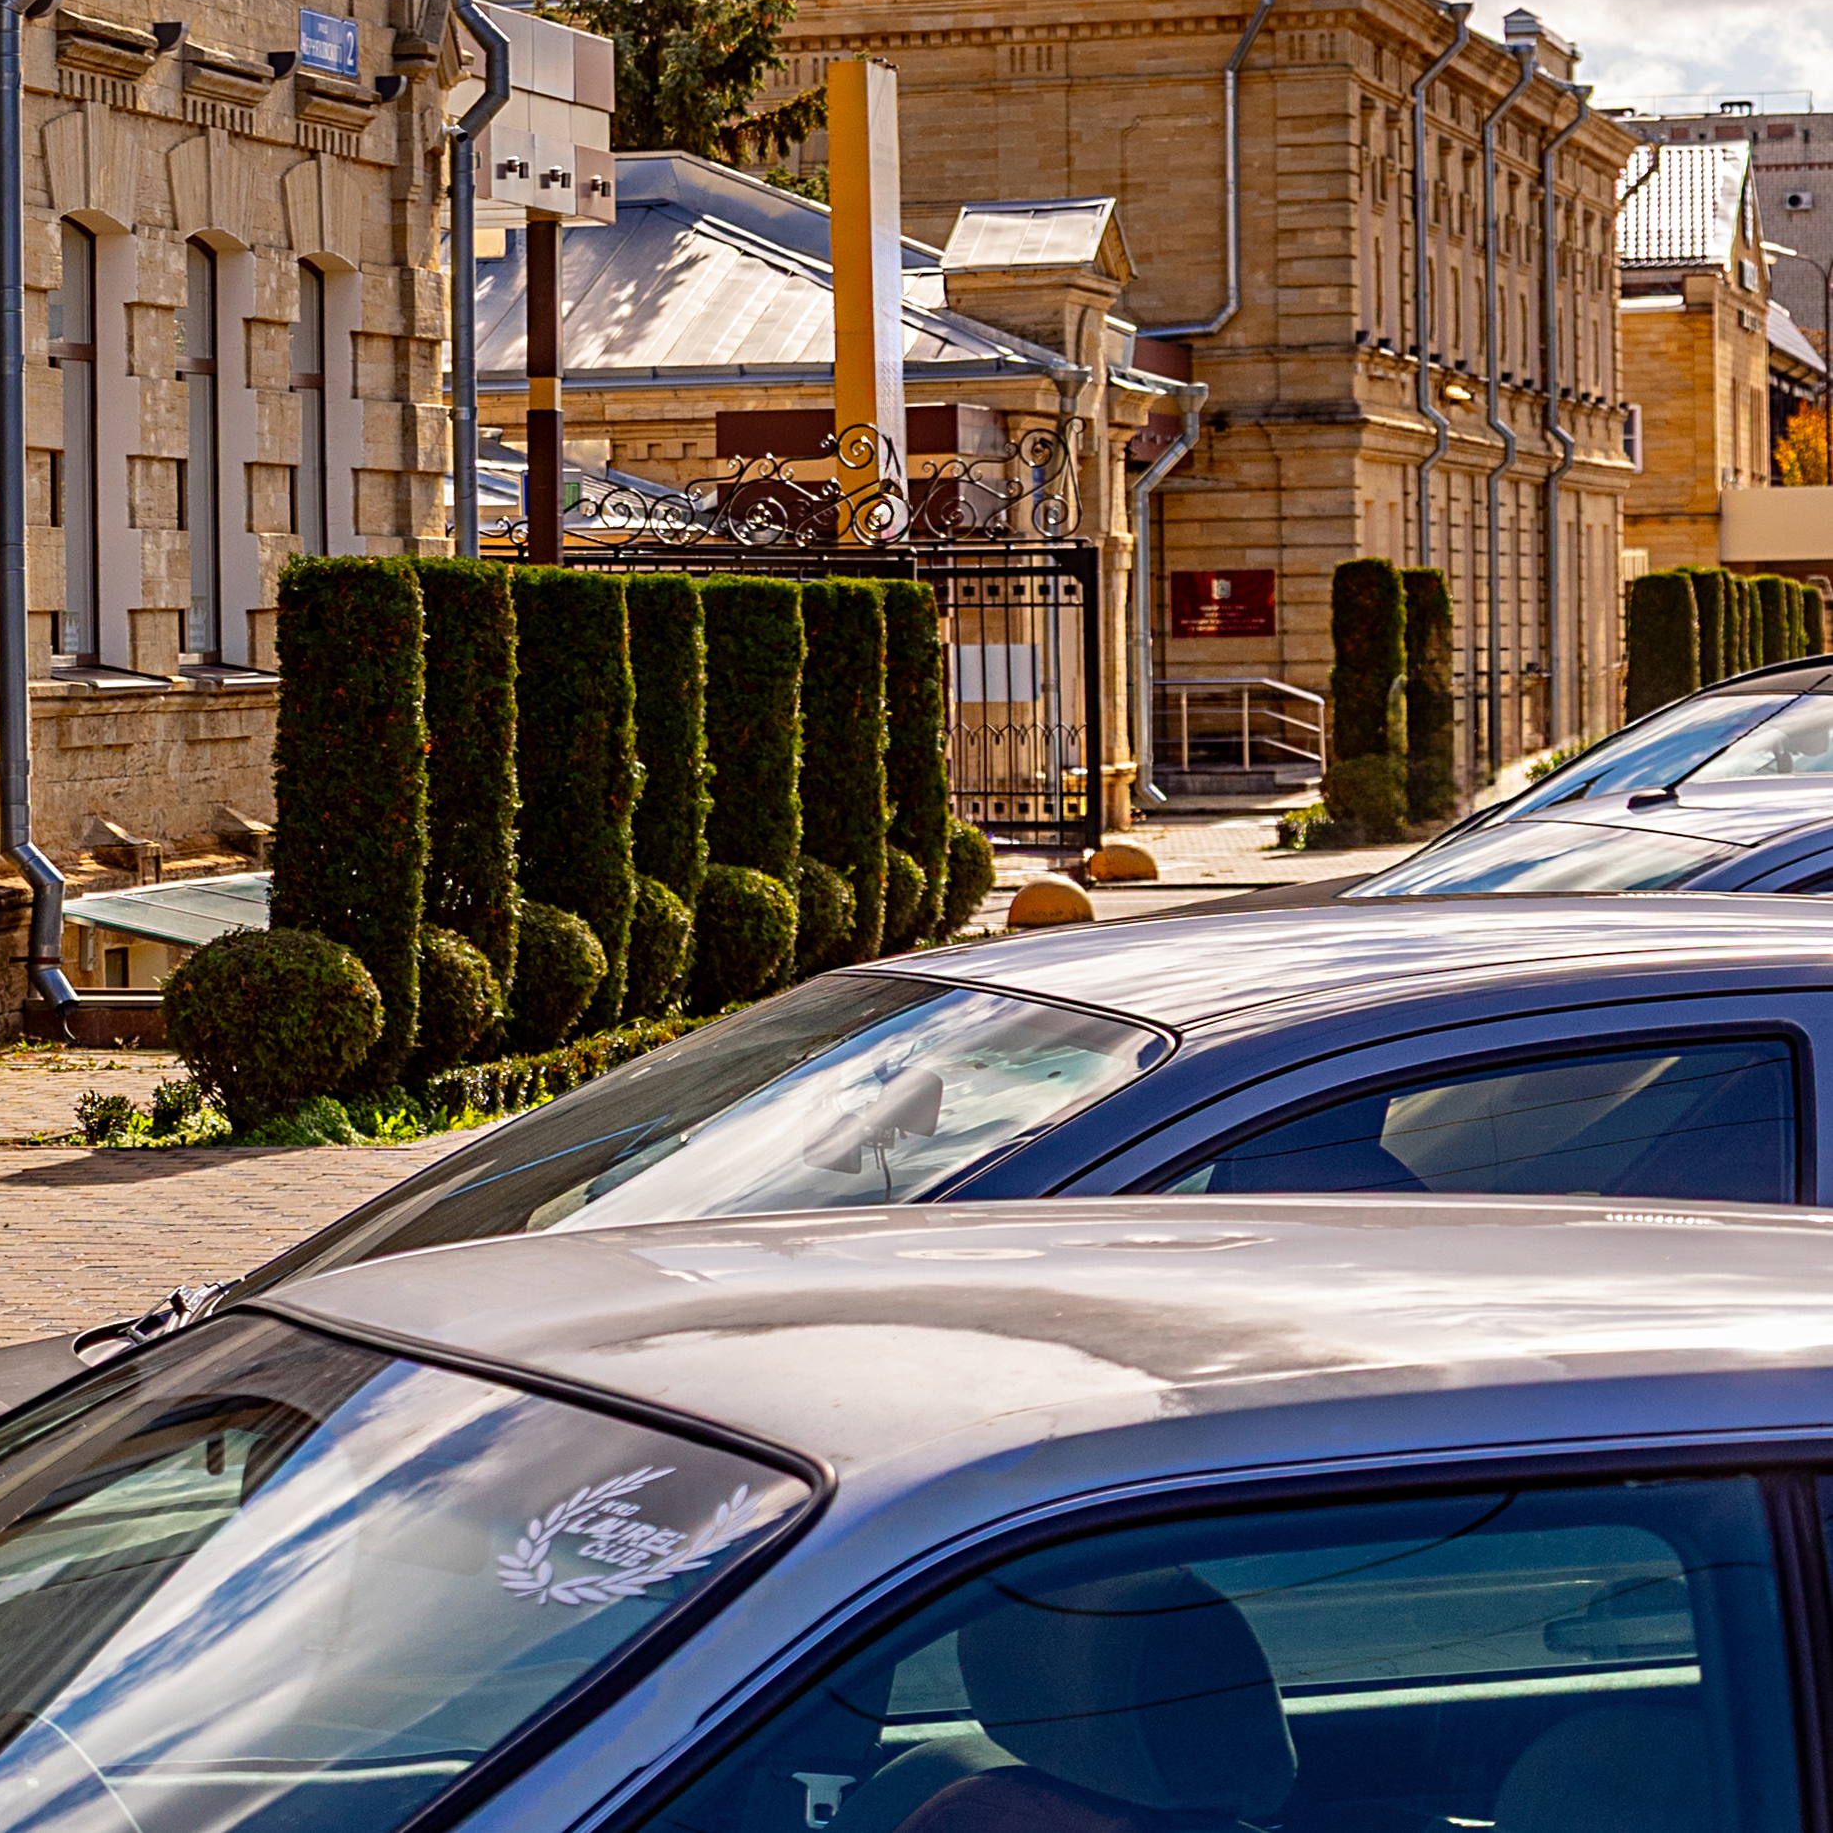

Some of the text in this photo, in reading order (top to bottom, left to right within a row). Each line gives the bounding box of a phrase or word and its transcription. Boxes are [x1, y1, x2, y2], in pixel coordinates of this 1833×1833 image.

[346, 31, 354, 66] 2
[598, 1500, 642, 1517] KRD
[563, 1512, 688, 1557] LAUREL
[578, 1540, 652, 1568] CLUB
